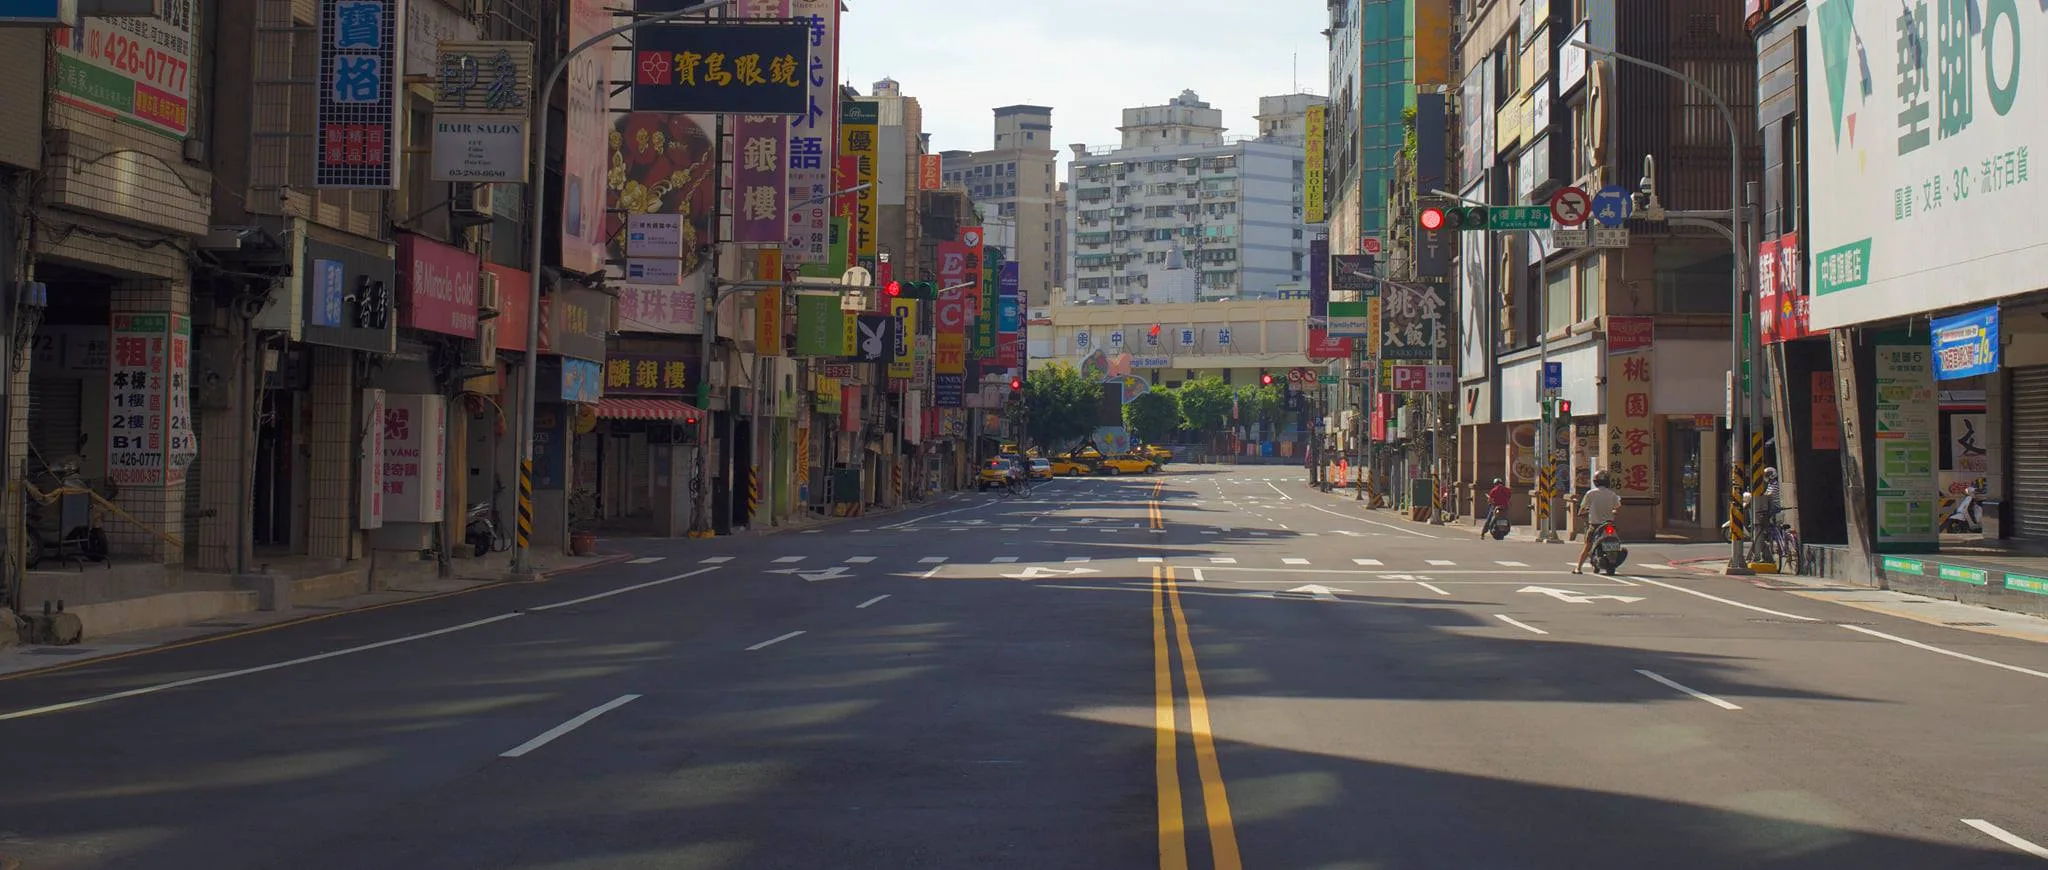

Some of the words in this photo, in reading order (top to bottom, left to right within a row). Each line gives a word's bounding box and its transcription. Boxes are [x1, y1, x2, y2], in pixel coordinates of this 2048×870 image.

[104, 32, 188, 92] 426-0777
[336, 3, 381, 101] 寶格
[674, 50, 801, 88] 寶島眼鏡
[439, 123, 471, 133] HAIR
[477, 123, 520, 133] SALON
[743, 115, 778, 221] 銀樓
[1309, 170, 1319, 208] HOTEL
[455, 271, 474, 306] Gold
[941, 252, 964, 326] EEC
[1330, 320, 1367, 331] FamilyMart
[1384, 321, 1448, 348] 大飯店
[115, 337, 147, 366] 租
[113, 371, 146, 389] 本棟
[114, 394, 144, 408] 1樓
[112, 415, 144, 428] 2樓
[1623, 357, 1650, 492] 桃園客運
[113, 437, 142, 449] B1
